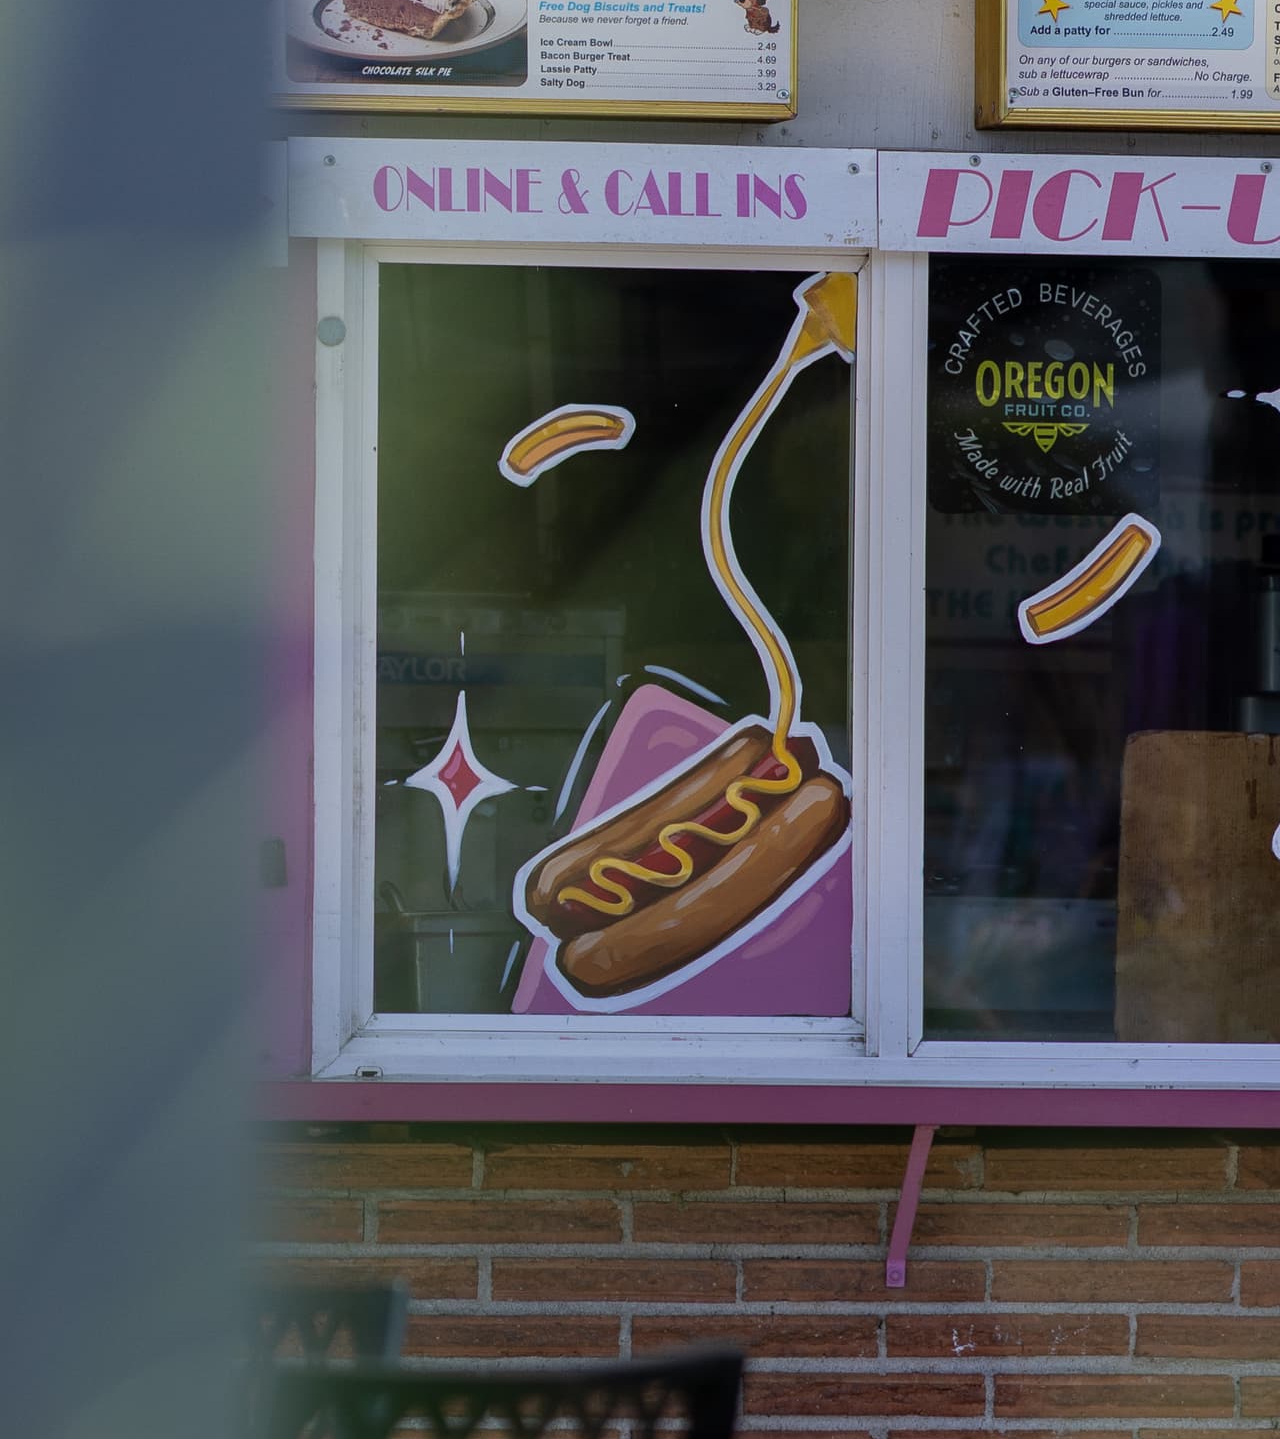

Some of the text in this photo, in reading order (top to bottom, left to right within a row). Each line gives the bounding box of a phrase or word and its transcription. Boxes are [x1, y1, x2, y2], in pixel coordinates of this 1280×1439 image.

[538, 1, 707, 14] Free Dog Biscuits and Treats!
[362, 65, 452, 76] CHOCOLATE SILK PIE
[373, 165, 807, 220] ONLINE & CALL INS
[945, 282, 1147, 378] CRAFTED BEVERAGES
[976, 360, 1115, 410] OREGON
[1005, 402, 1090, 417] FRUIT CO.
[954, 428, 1132, 499] Made with Real Fruit
